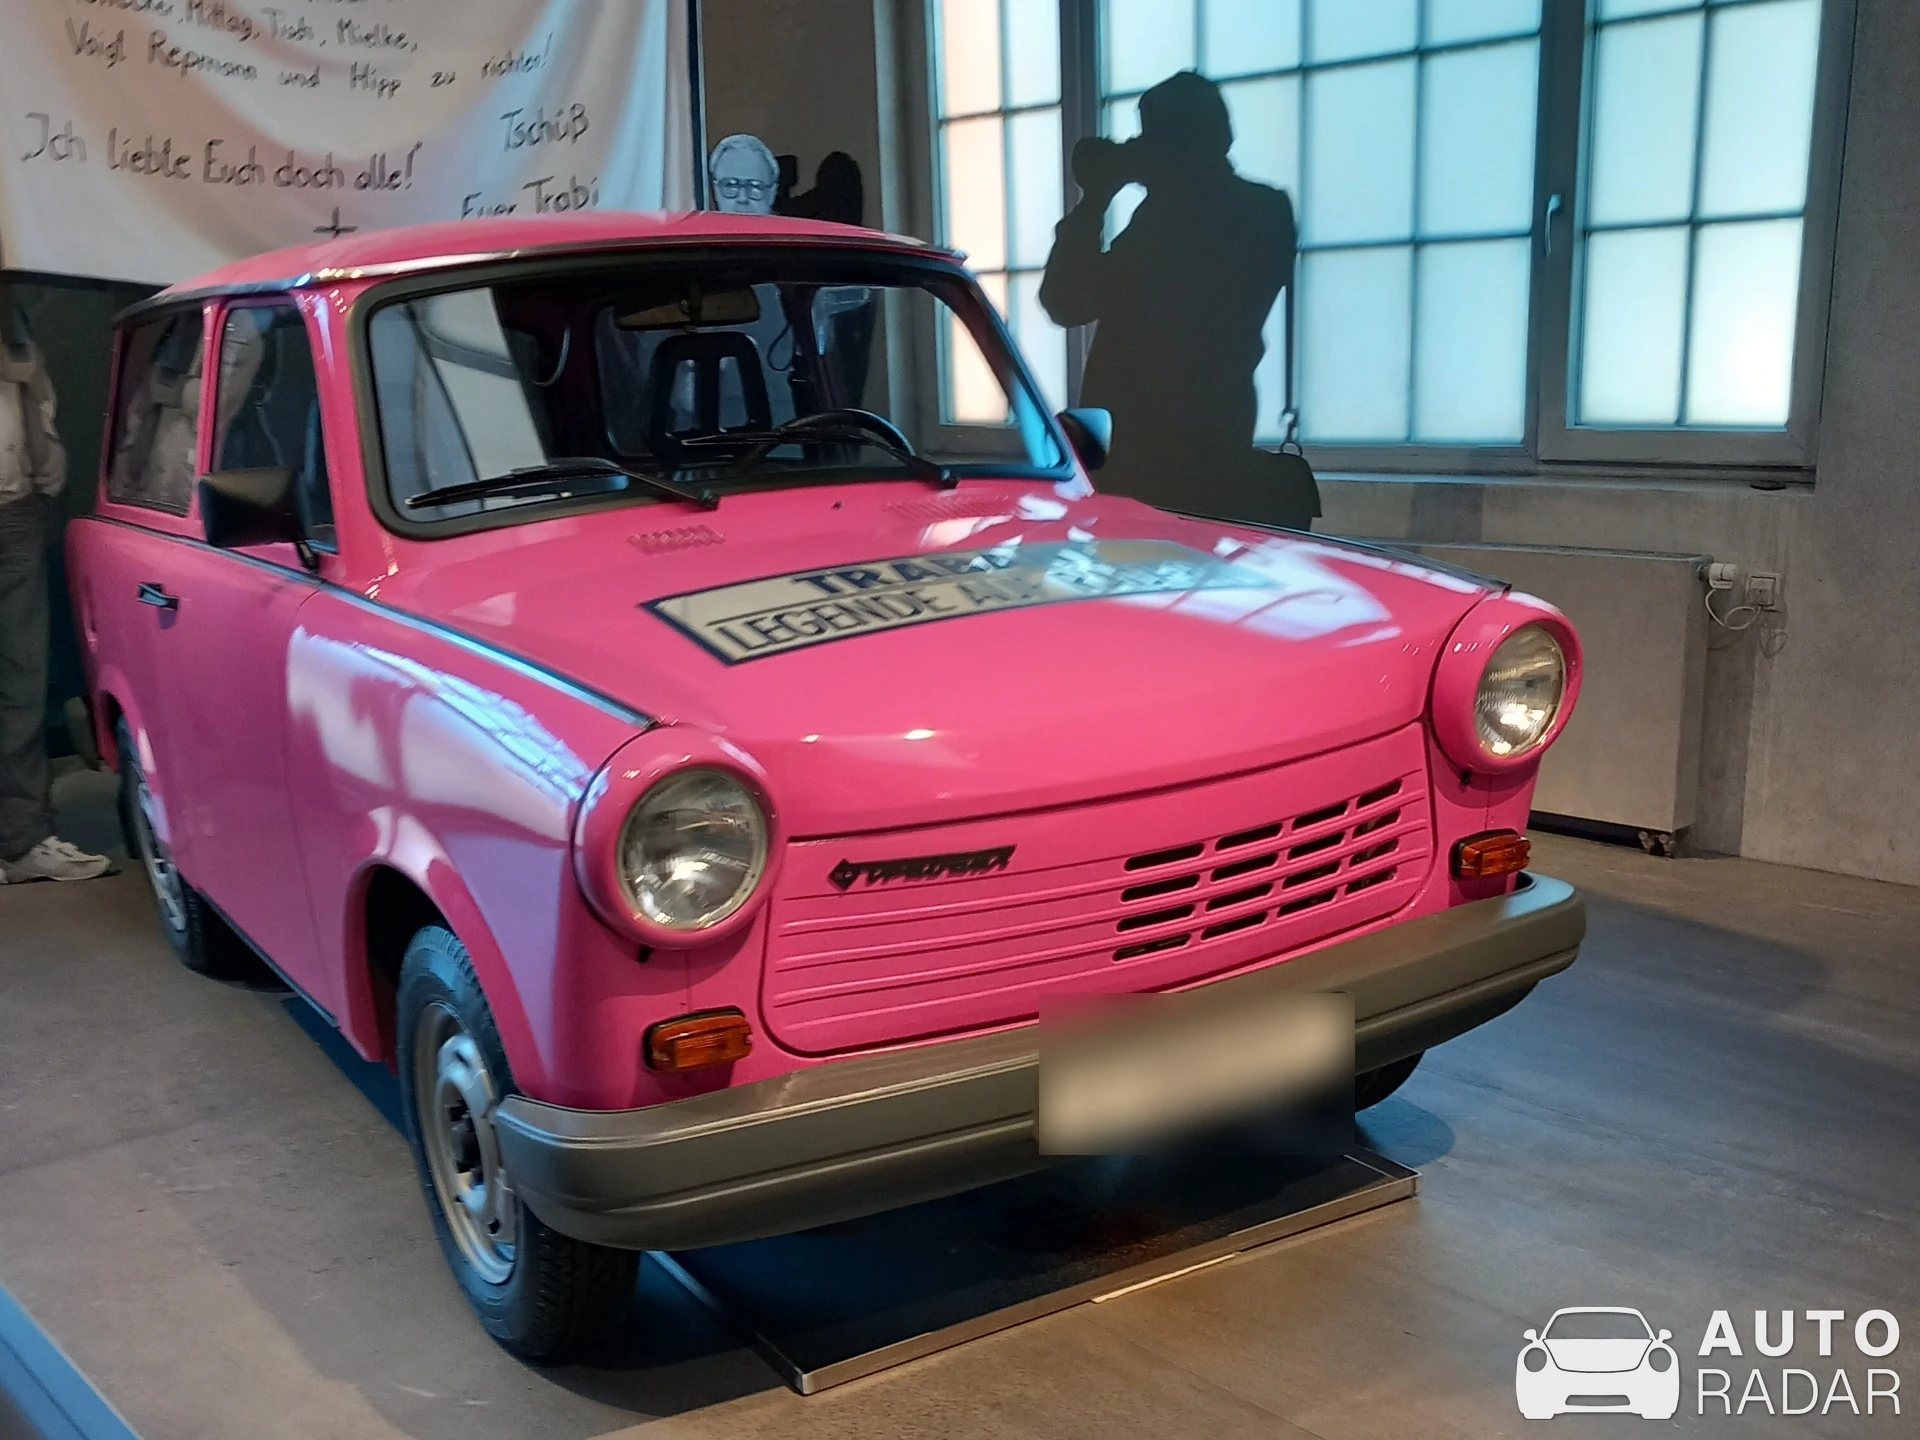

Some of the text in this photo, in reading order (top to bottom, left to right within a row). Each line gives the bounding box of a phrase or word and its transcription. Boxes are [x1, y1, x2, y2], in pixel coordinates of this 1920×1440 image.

[276, 66, 320, 89] und
[350, 61, 402, 100] Hipp
[430, 71, 456, 88] zu
[202, 138, 265, 186] Euch
[272, 149, 346, 190] doch
[353, 141, 424, 191] alle!
[521, 174, 600, 214] Trabi
[714, 586, 960, 652] LEGENDE
